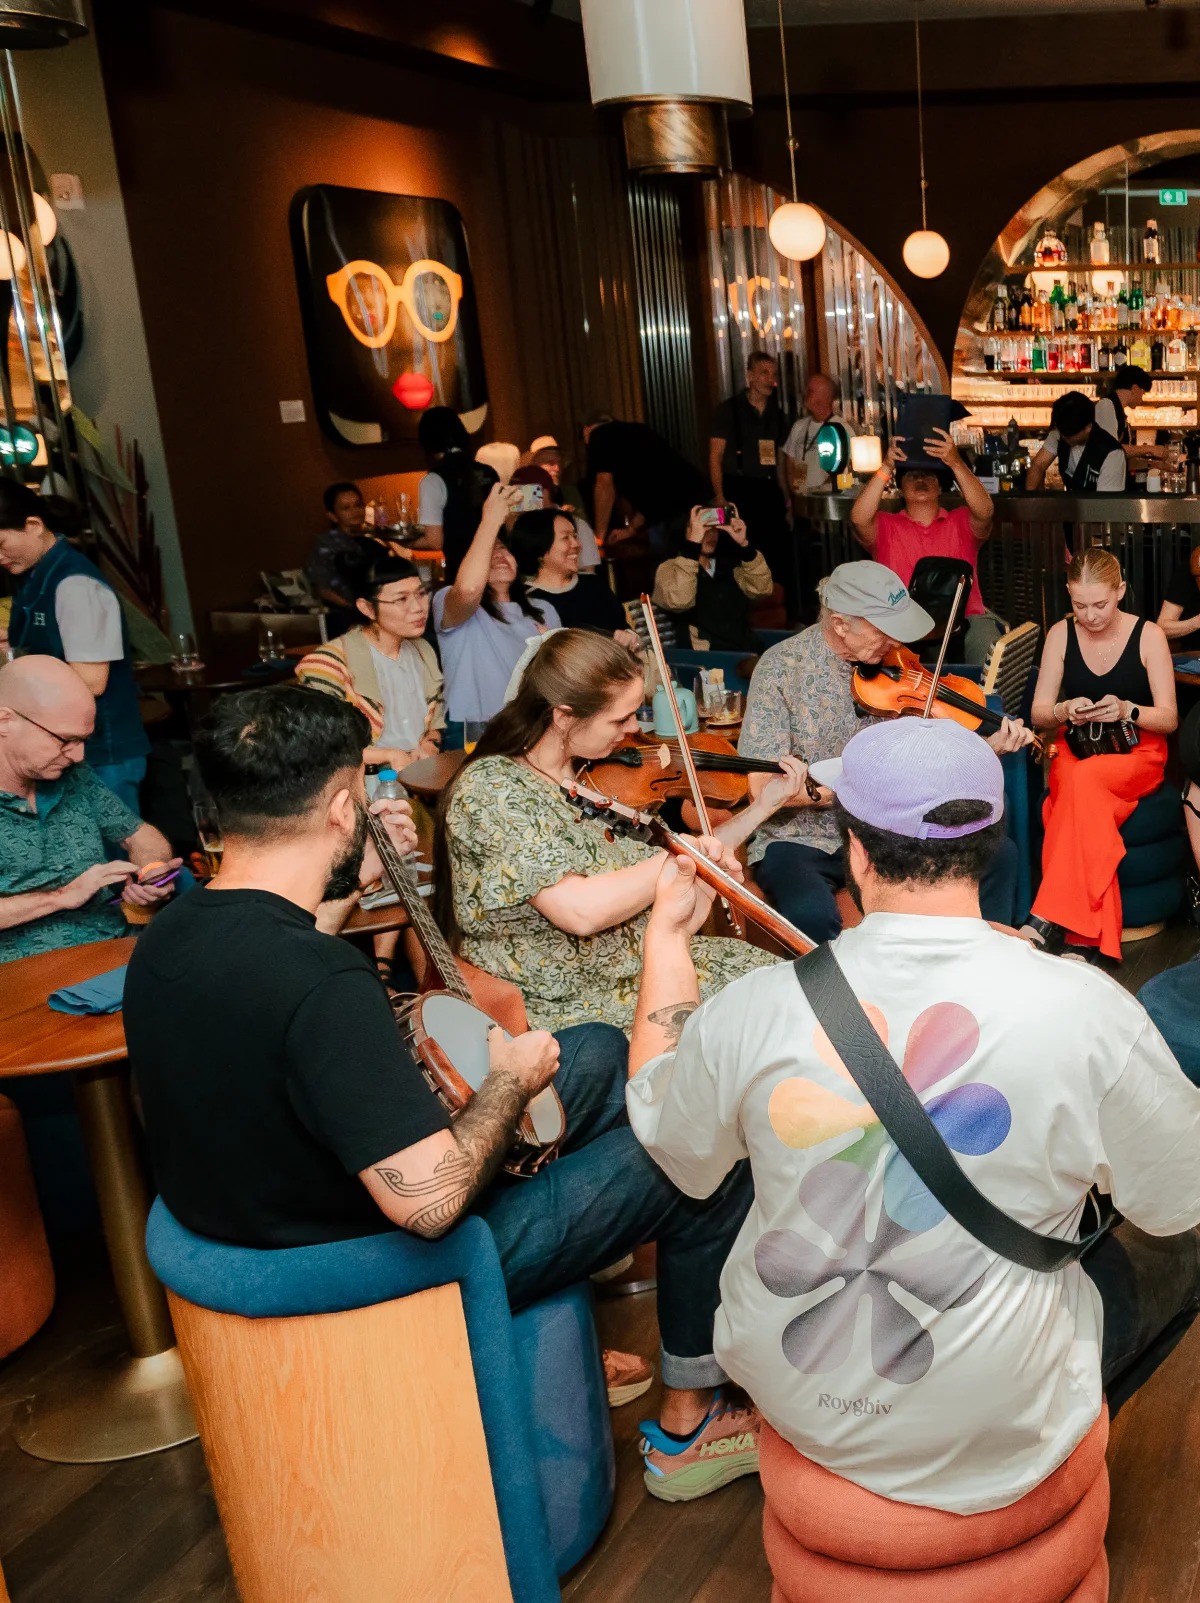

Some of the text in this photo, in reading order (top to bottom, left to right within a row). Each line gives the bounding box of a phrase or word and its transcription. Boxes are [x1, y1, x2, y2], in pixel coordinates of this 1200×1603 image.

[34, 612, 46, 626] H
[818, 1394, 892, 1417] Roygbiv
[700, 1433, 755, 1457] HOKA
